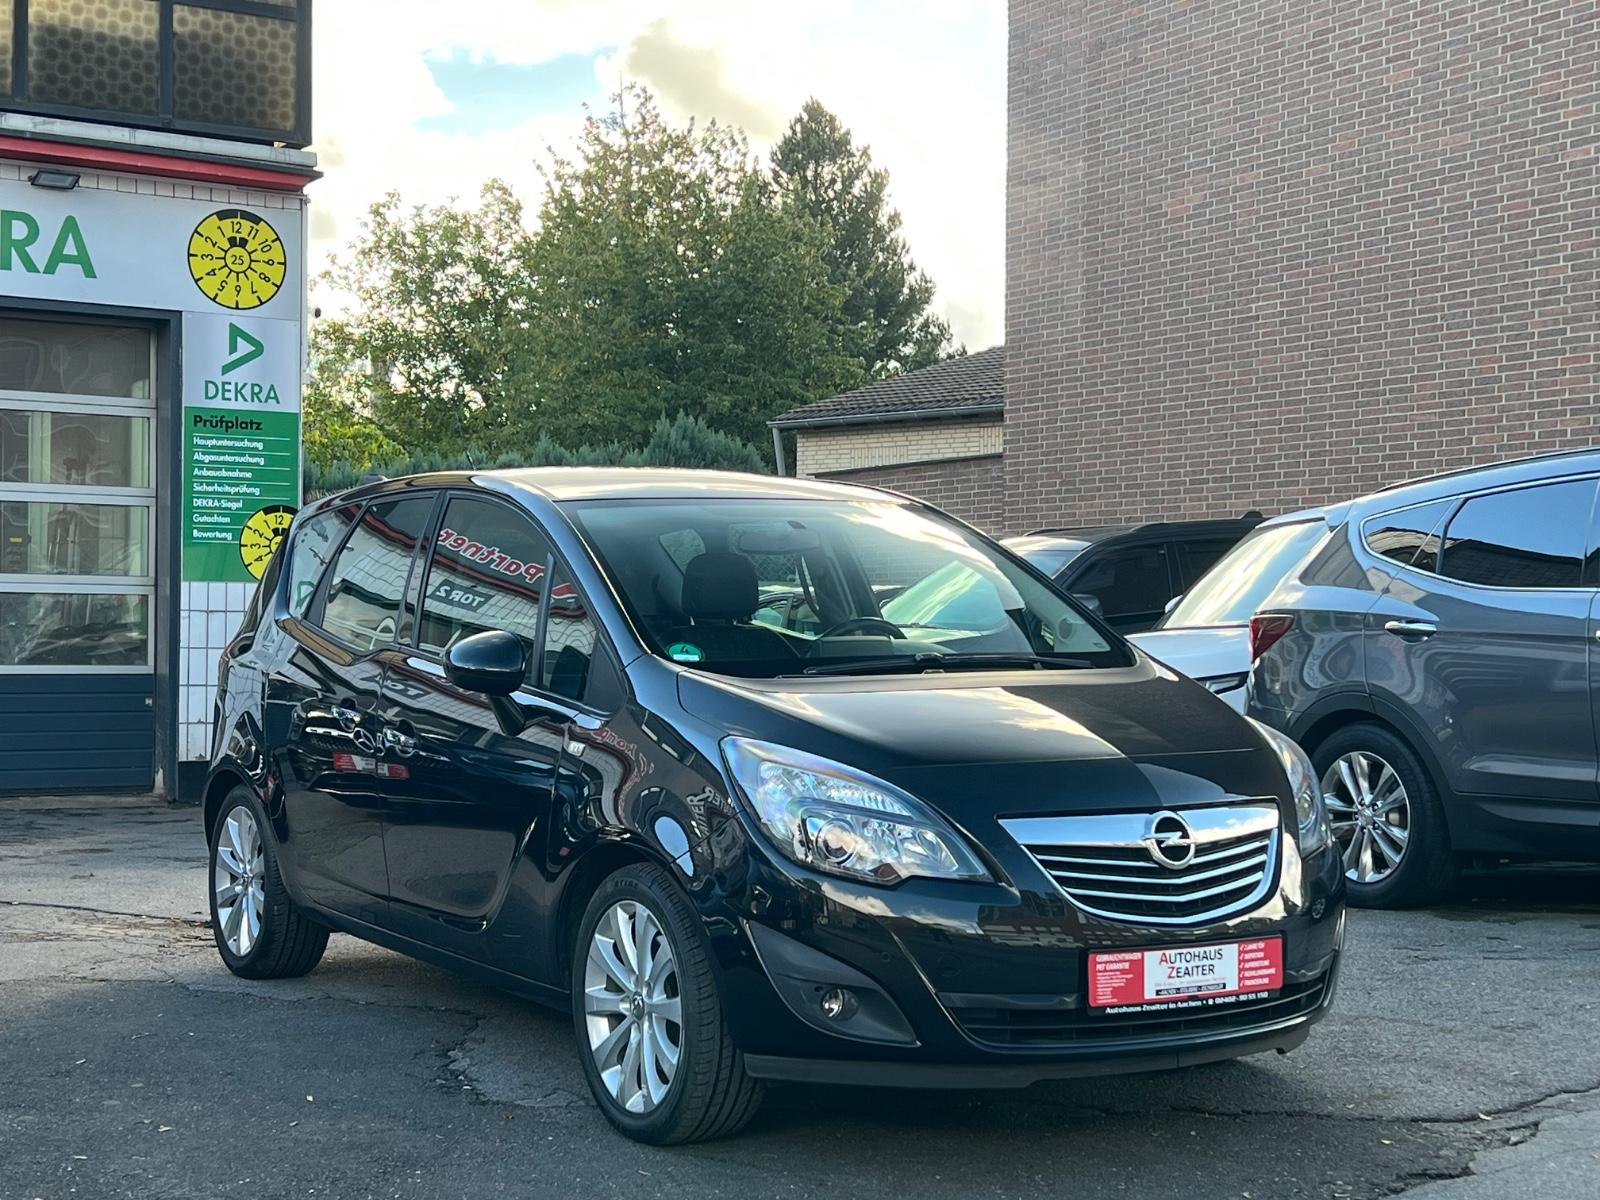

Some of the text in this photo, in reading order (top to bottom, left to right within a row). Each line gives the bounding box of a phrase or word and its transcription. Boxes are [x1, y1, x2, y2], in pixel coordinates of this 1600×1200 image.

[230, 220, 242, 234] 12
[230, 255, 244, 266] 25
[204, 380, 280, 404] DEKRA
[193, 414, 263, 432] Prüfplatz
[193, 436, 263, 450] Hauptuntersuchung
[193, 452, 264, 466] Abgasuntersuchung
[193, 468, 252, 478] Anbauabnahme
[193, 482, 260, 496] Sicherheitsprüfung
[193, 498, 242, 510] DEKRA-Siegel
[193, 514, 230, 523] Gutachten
[274, 515, 284, 525] 12
[193, 529, 232, 540] Bewertung
[1159, 948, 1223, 965] AUTOHAUS
[1167, 964, 1215, 979] ZEAITER
